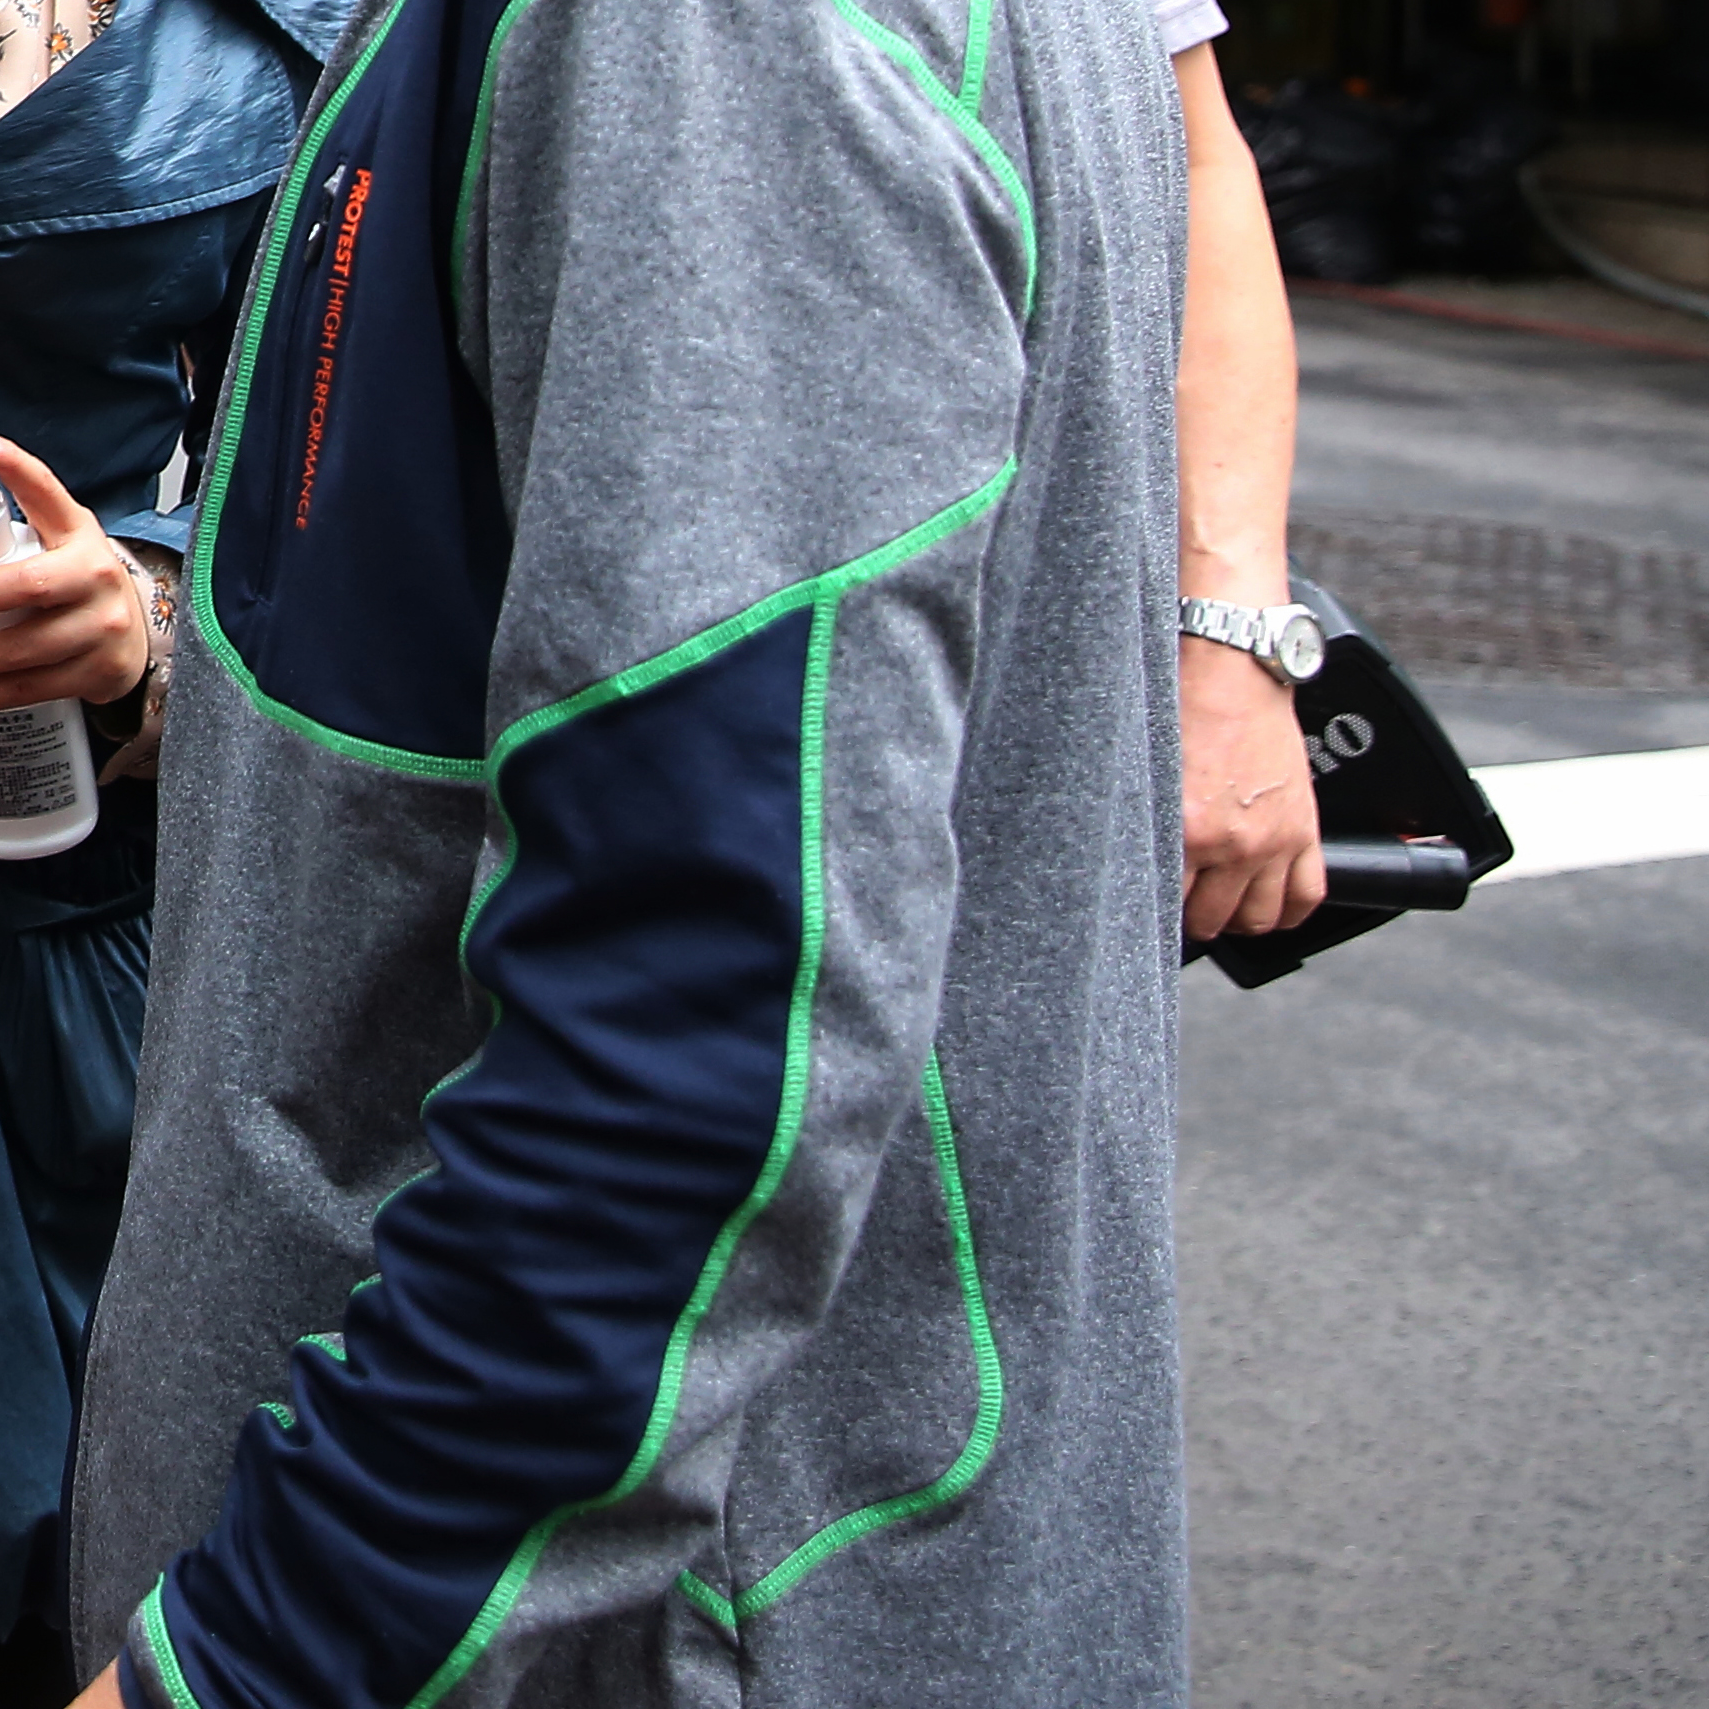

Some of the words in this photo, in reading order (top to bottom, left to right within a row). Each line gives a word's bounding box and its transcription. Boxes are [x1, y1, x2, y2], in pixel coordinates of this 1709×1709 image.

[331, 168, 373, 278] PROTEST
[320, 287, 345, 350] HIGH
[294, 355, 333, 530] PERFORMANCE
